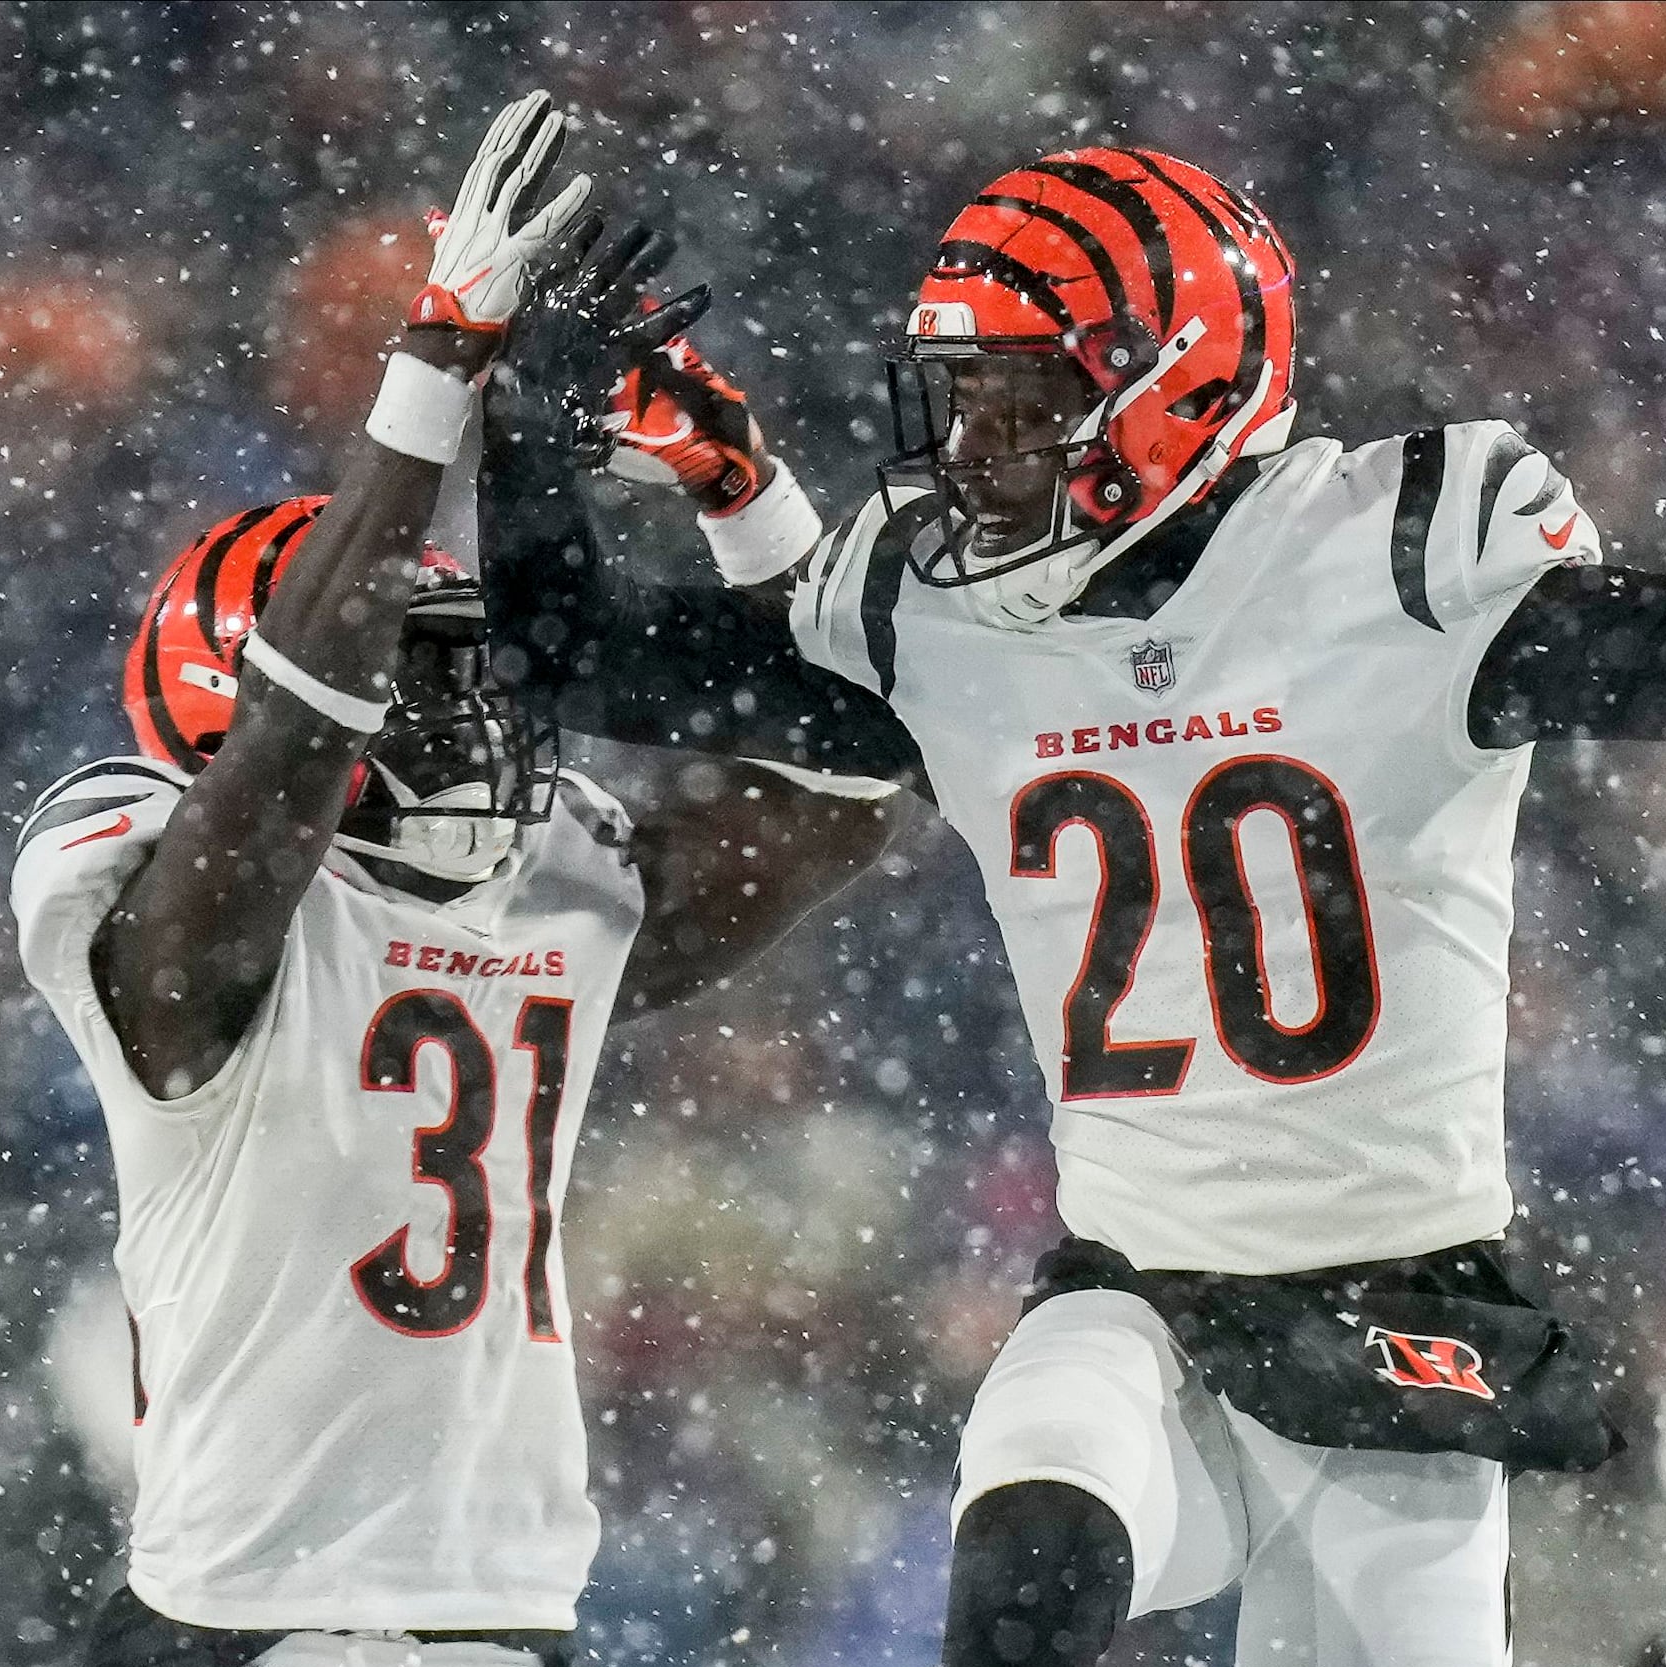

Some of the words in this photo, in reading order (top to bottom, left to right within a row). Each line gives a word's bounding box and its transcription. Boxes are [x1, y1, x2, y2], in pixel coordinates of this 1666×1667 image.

[1137, 664, 1169, 687] NFL
[1034, 706, 1284, 760] BENGALS
[1009, 753, 1382, 1102] 20
[384, 940, 567, 977] BENGALS
[349, 987, 575, 1344] 31
